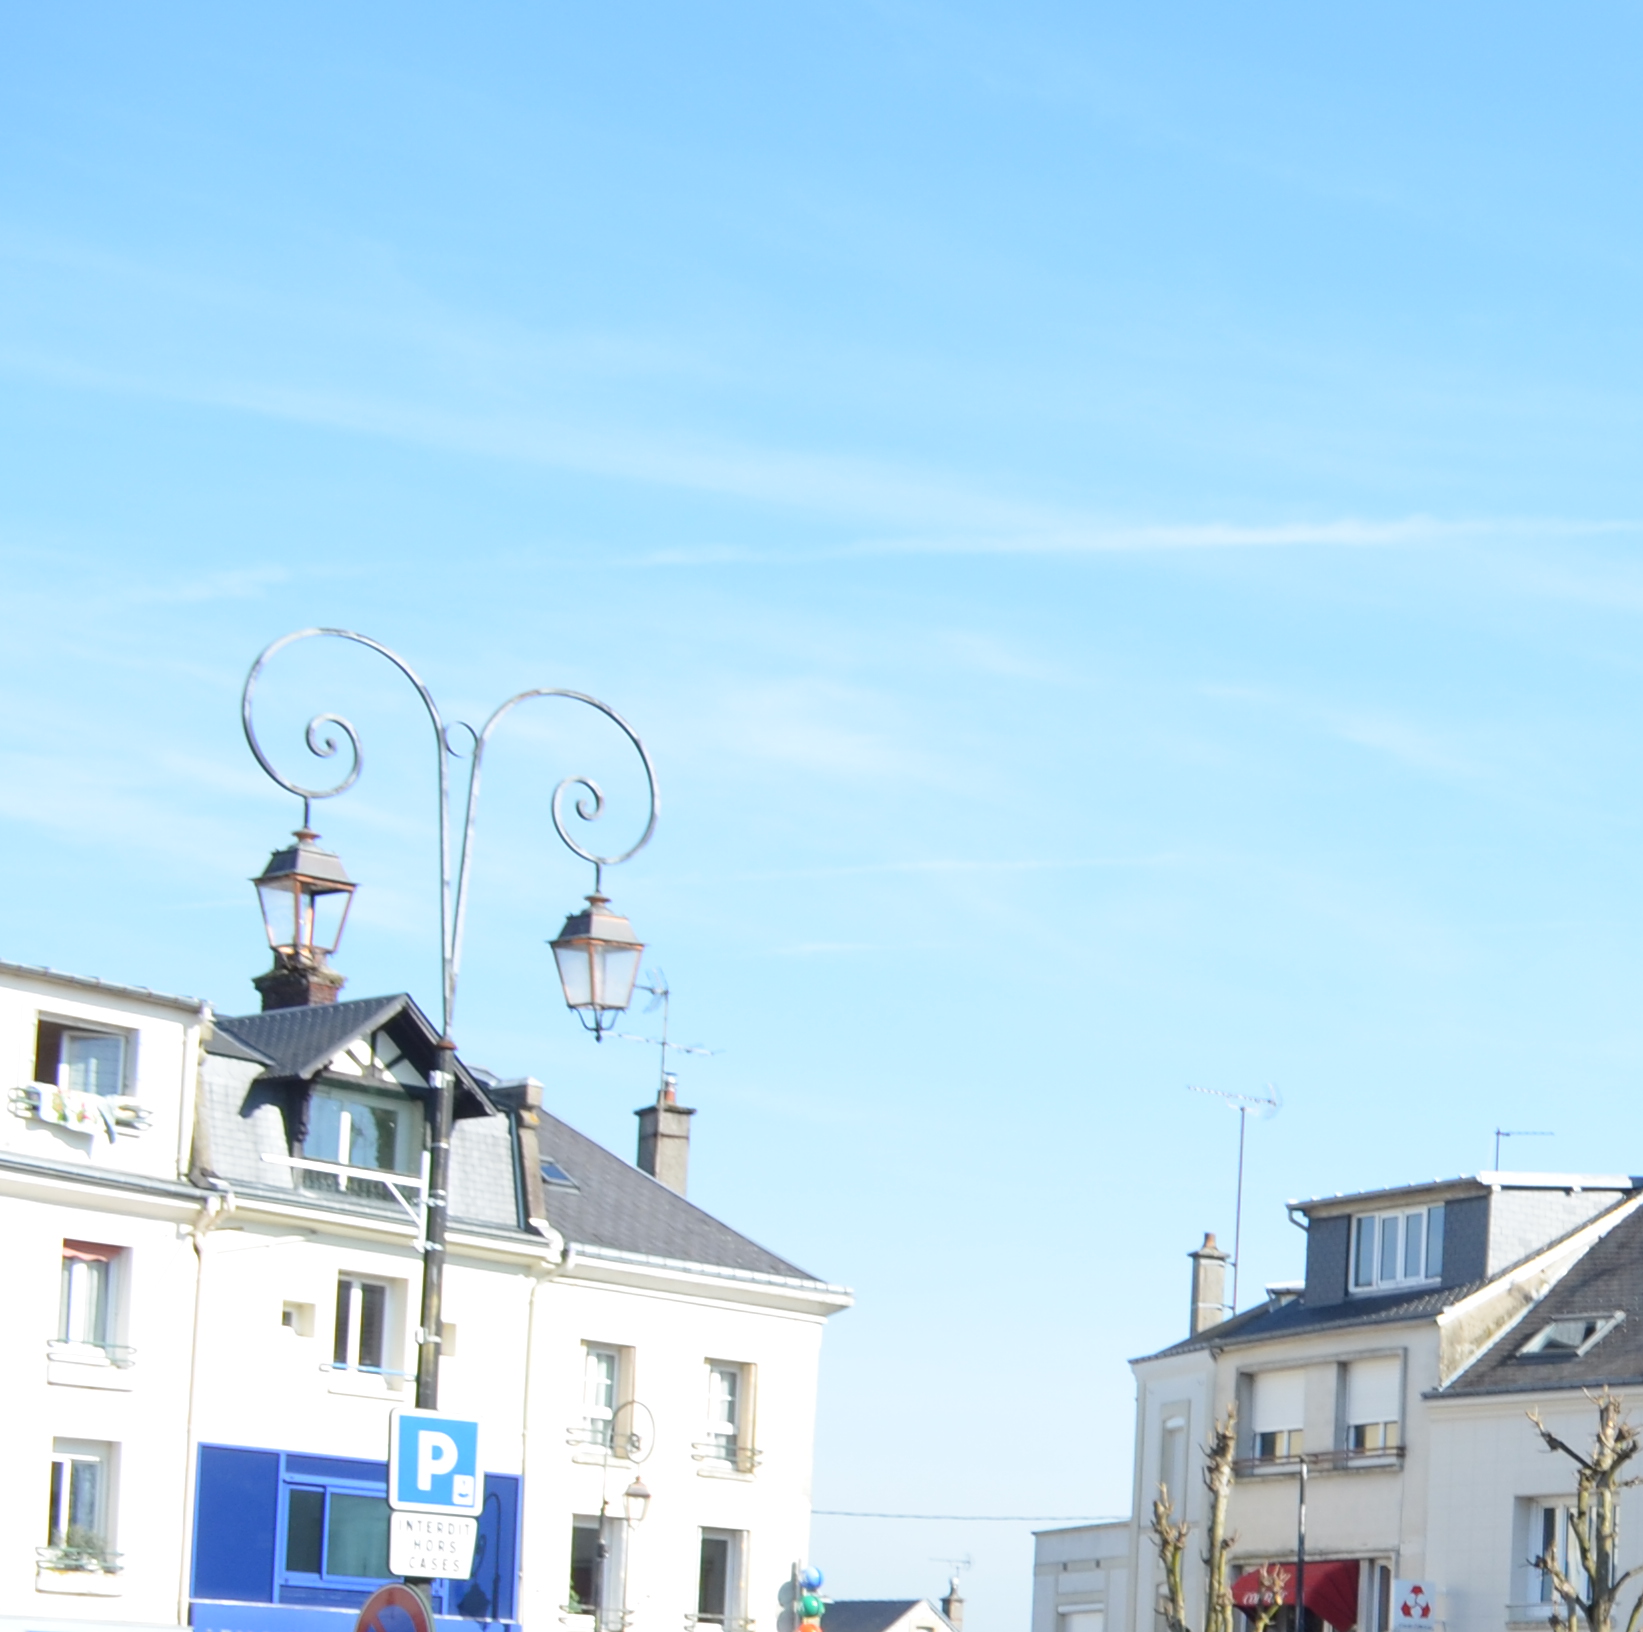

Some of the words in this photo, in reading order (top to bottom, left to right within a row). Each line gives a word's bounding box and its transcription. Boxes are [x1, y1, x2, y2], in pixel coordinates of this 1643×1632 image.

[417, 1430, 458, 1491] P
[399, 1519, 470, 1536] INTERDIT
[414, 1539, 456, 1553] HORS
[409, 1556, 460, 1572] CASES
